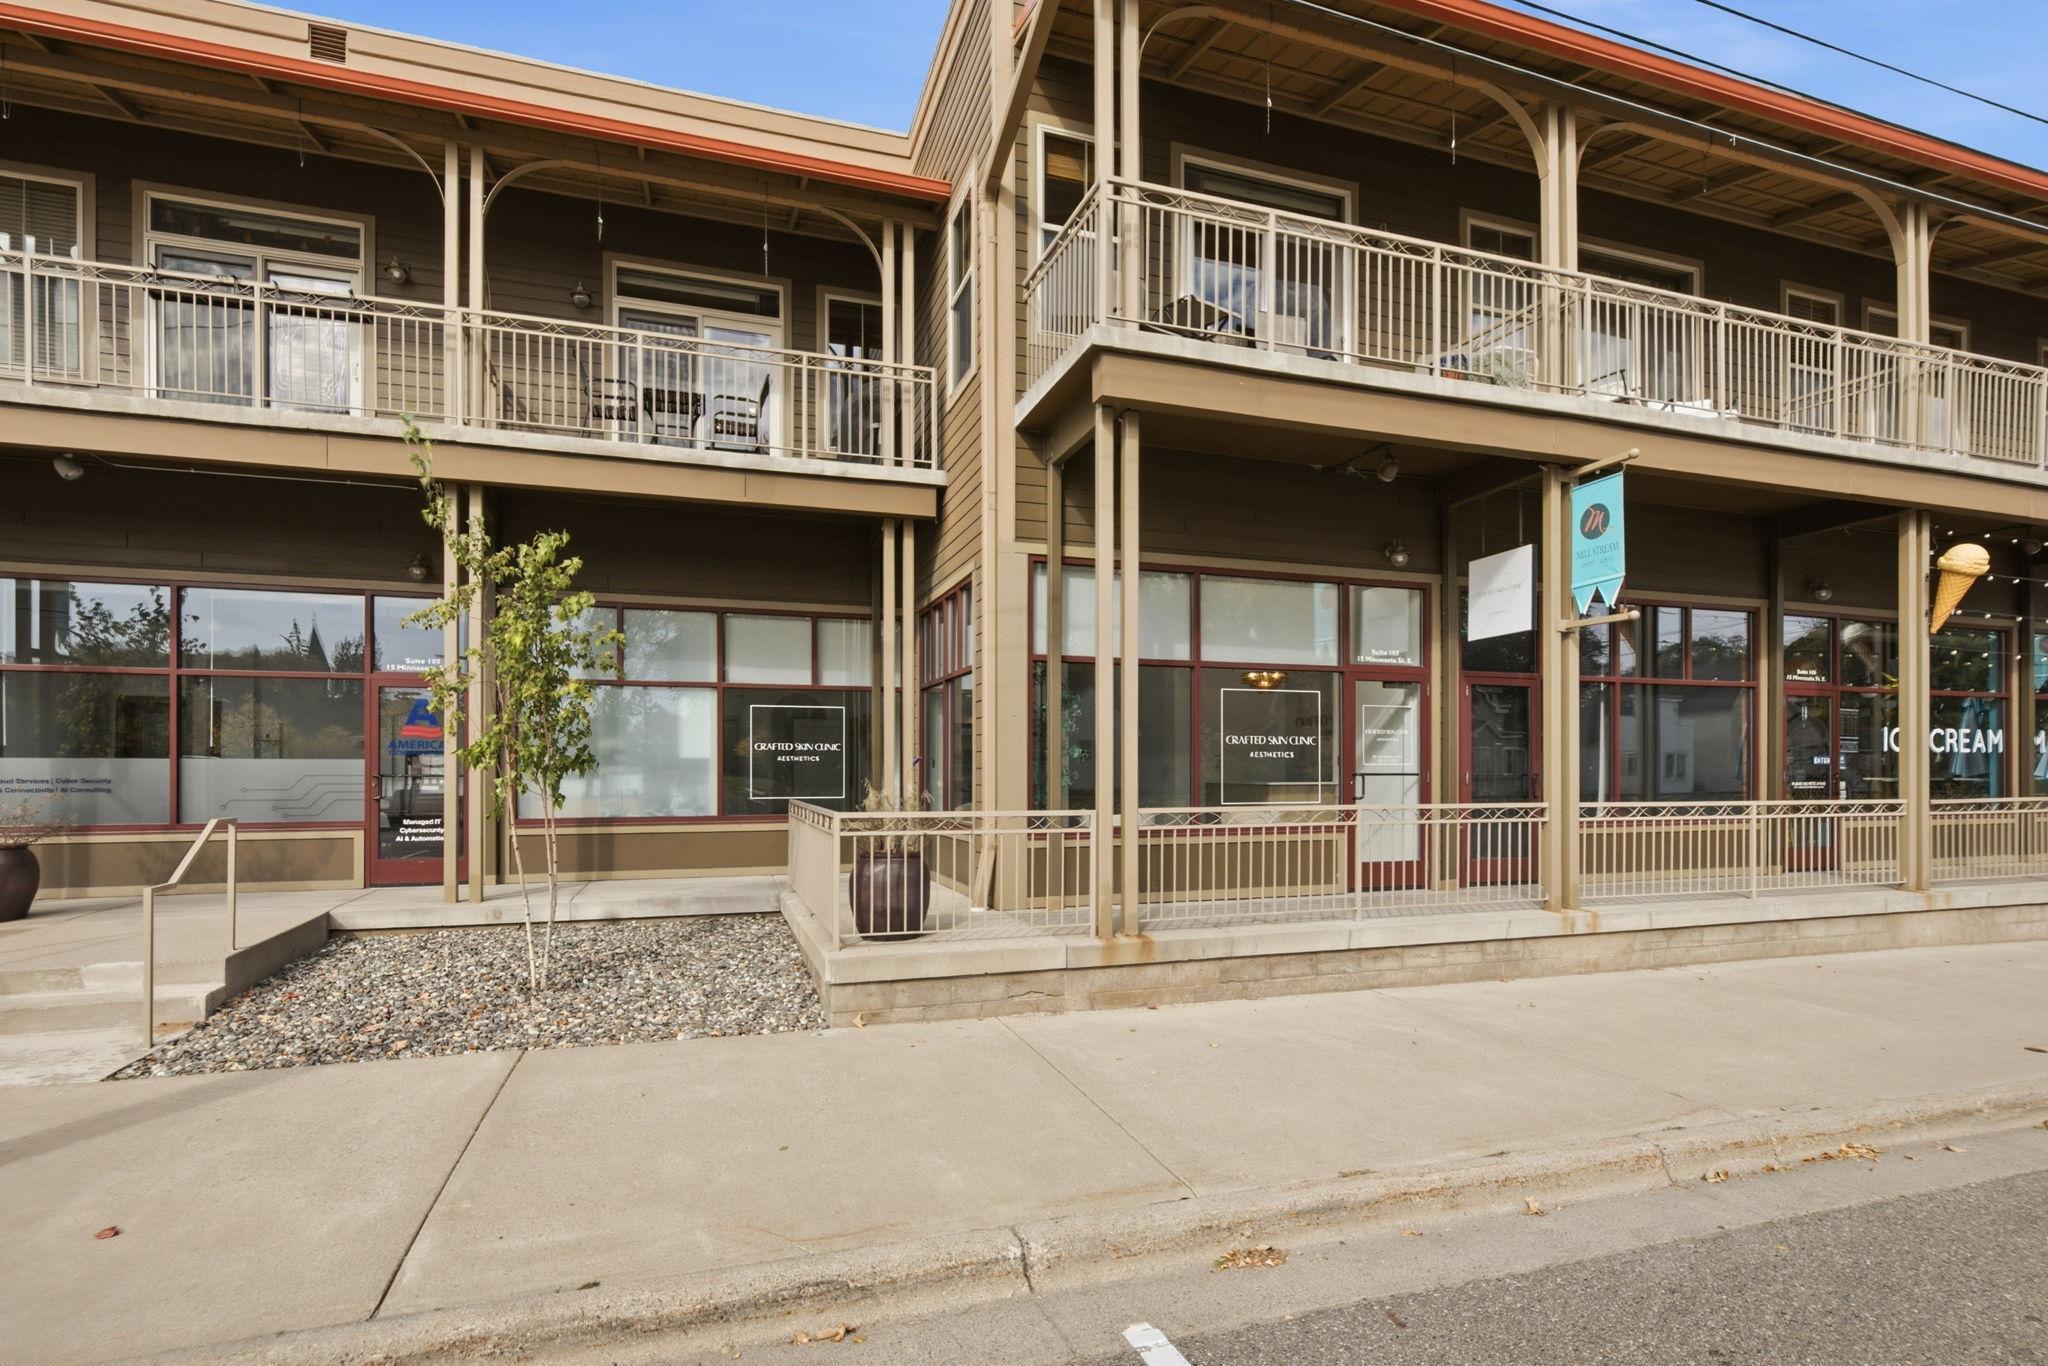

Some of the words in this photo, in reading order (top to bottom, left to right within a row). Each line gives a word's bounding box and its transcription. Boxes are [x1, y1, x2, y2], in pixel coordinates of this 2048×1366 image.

[1225, 735, 1266, 745] CRAFTED
[1267, 735, 1288, 746] SKIN
[1289, 735, 1317, 746] CLINIC
[1929, 727, 2004, 754] CREAM
[754, 742, 794, 751] CRAFTED
[794, 742, 814, 751] SKIN
[814, 743, 842, 751] CLINIC
